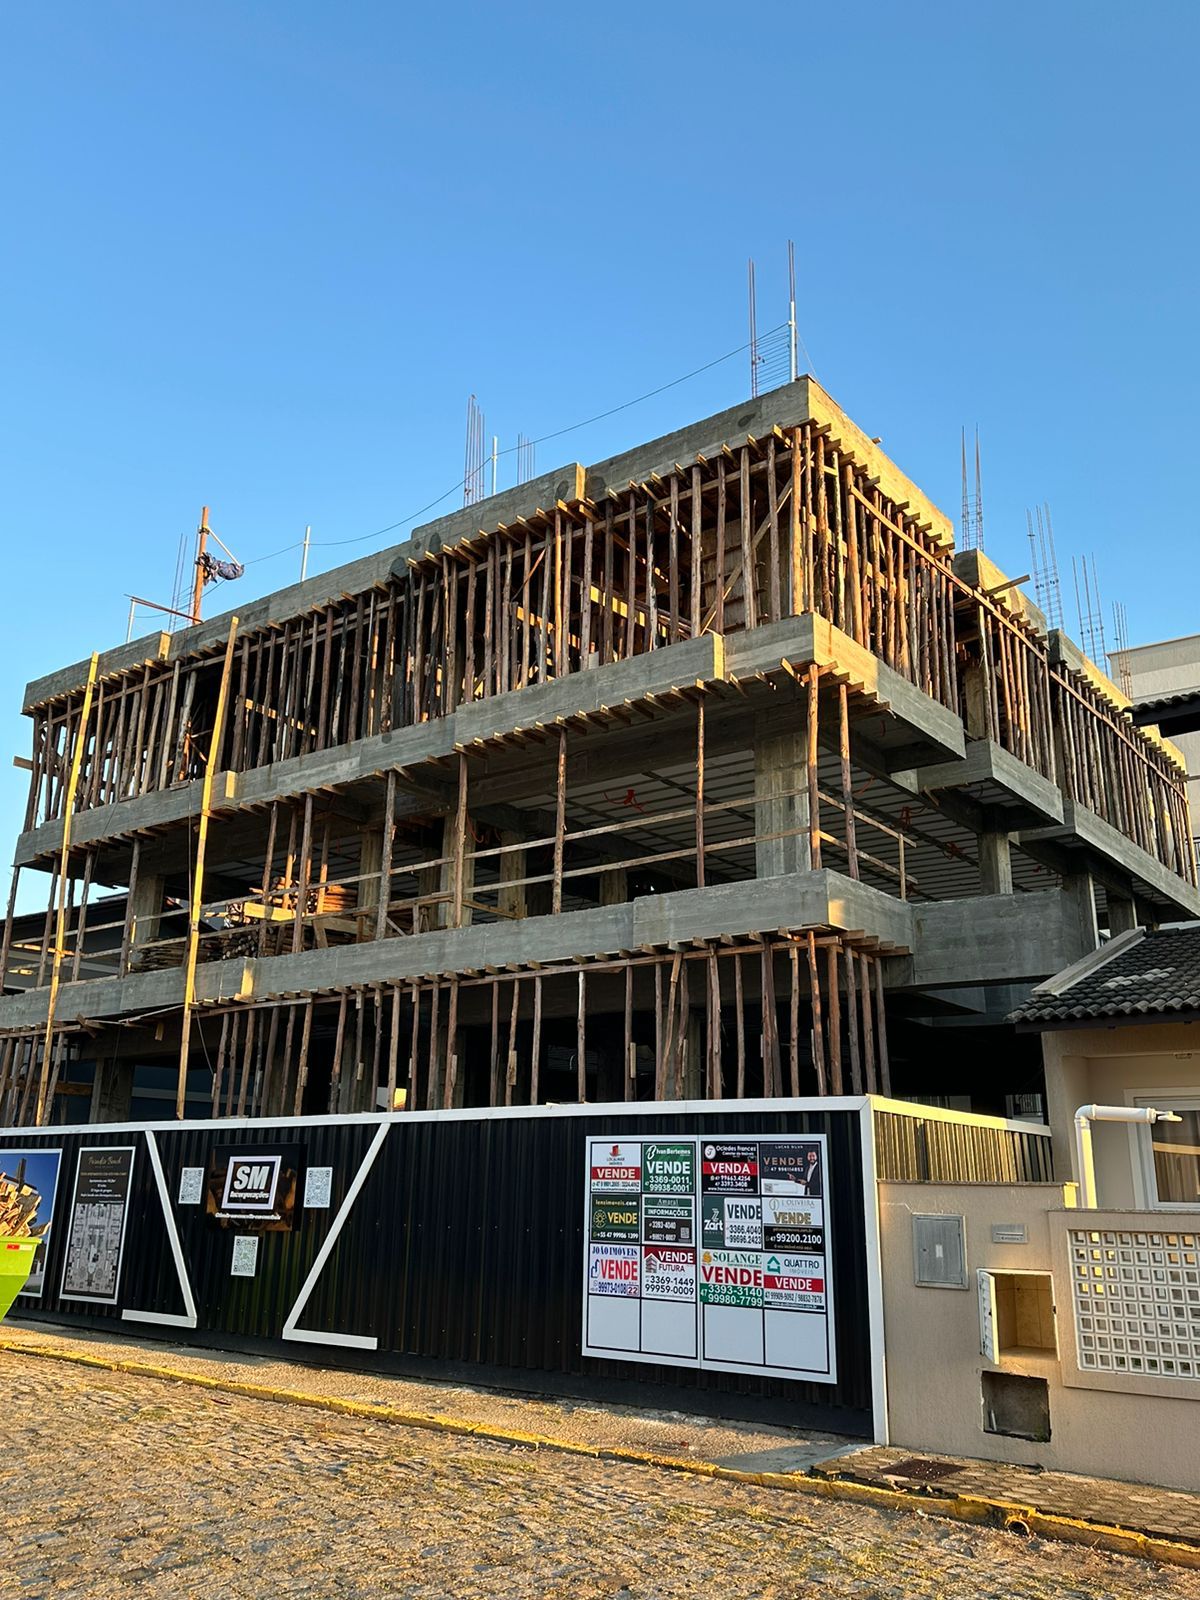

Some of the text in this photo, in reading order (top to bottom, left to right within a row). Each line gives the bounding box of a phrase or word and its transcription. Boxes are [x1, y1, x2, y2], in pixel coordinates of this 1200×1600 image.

[763, 1157, 804, 1166] VENDE
[596, 1168, 636, 1178] VENDE
[646, 1161, 690, 1174] VENDE
[710, 1163, 750, 1174] VENDA
[234, 1166, 270, 1190] SM
[650, 1176, 690, 1184] 3369-0011
[650, 1184, 690, 1192] 99938-0001
[230, 1191, 269, 1199] Incorporações
[648, 1208, 688, 1217] INFORMAÇÕES
[727, 1204, 760, 1220] VENDE
[608, 1212, 638, 1224] VENDE
[773, 1212, 812, 1225] VENDE
[704, 1220, 723, 1231] Zart
[776, 1233, 822, 1244] 99200.2100
[592, 1246, 638, 1256] JOÃO IMÓVEIS
[658, 1251, 694, 1263] VENDE
[712, 1252, 762, 1264] SOLANGE
[601, 1259, 638, 1280] VENDE
[659, 1264, 685, 1272] FUTURA
[784, 1259, 820, 1269] QUATTRO
[650, 1275, 694, 1286] 3369-1449
[702, 1266, 762, 1286] VENDE
[774, 1277, 812, 1291] VENDE
[645, 1284, 694, 1296] 99959-0009
[700, 1289, 708, 1297] 47
[708, 1284, 762, 1297] 3393-3140
[708, 1294, 762, 1306] 99980-7799
